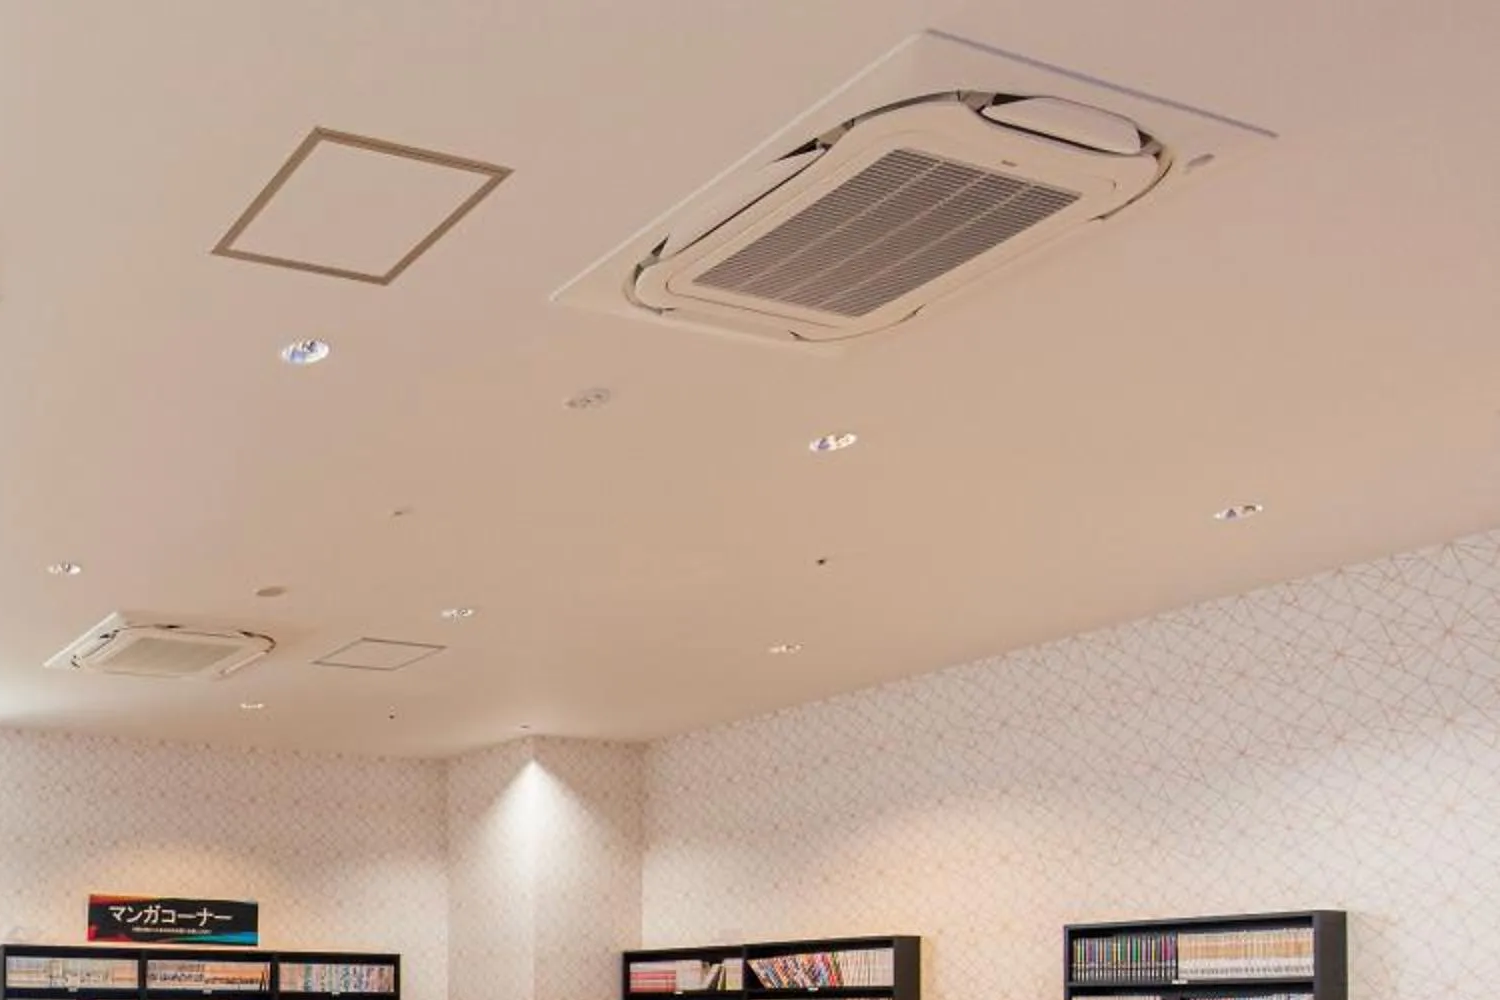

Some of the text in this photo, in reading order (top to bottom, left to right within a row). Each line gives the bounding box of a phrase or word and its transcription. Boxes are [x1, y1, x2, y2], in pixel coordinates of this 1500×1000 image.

[107, 904, 233, 927] マンガコーナー
